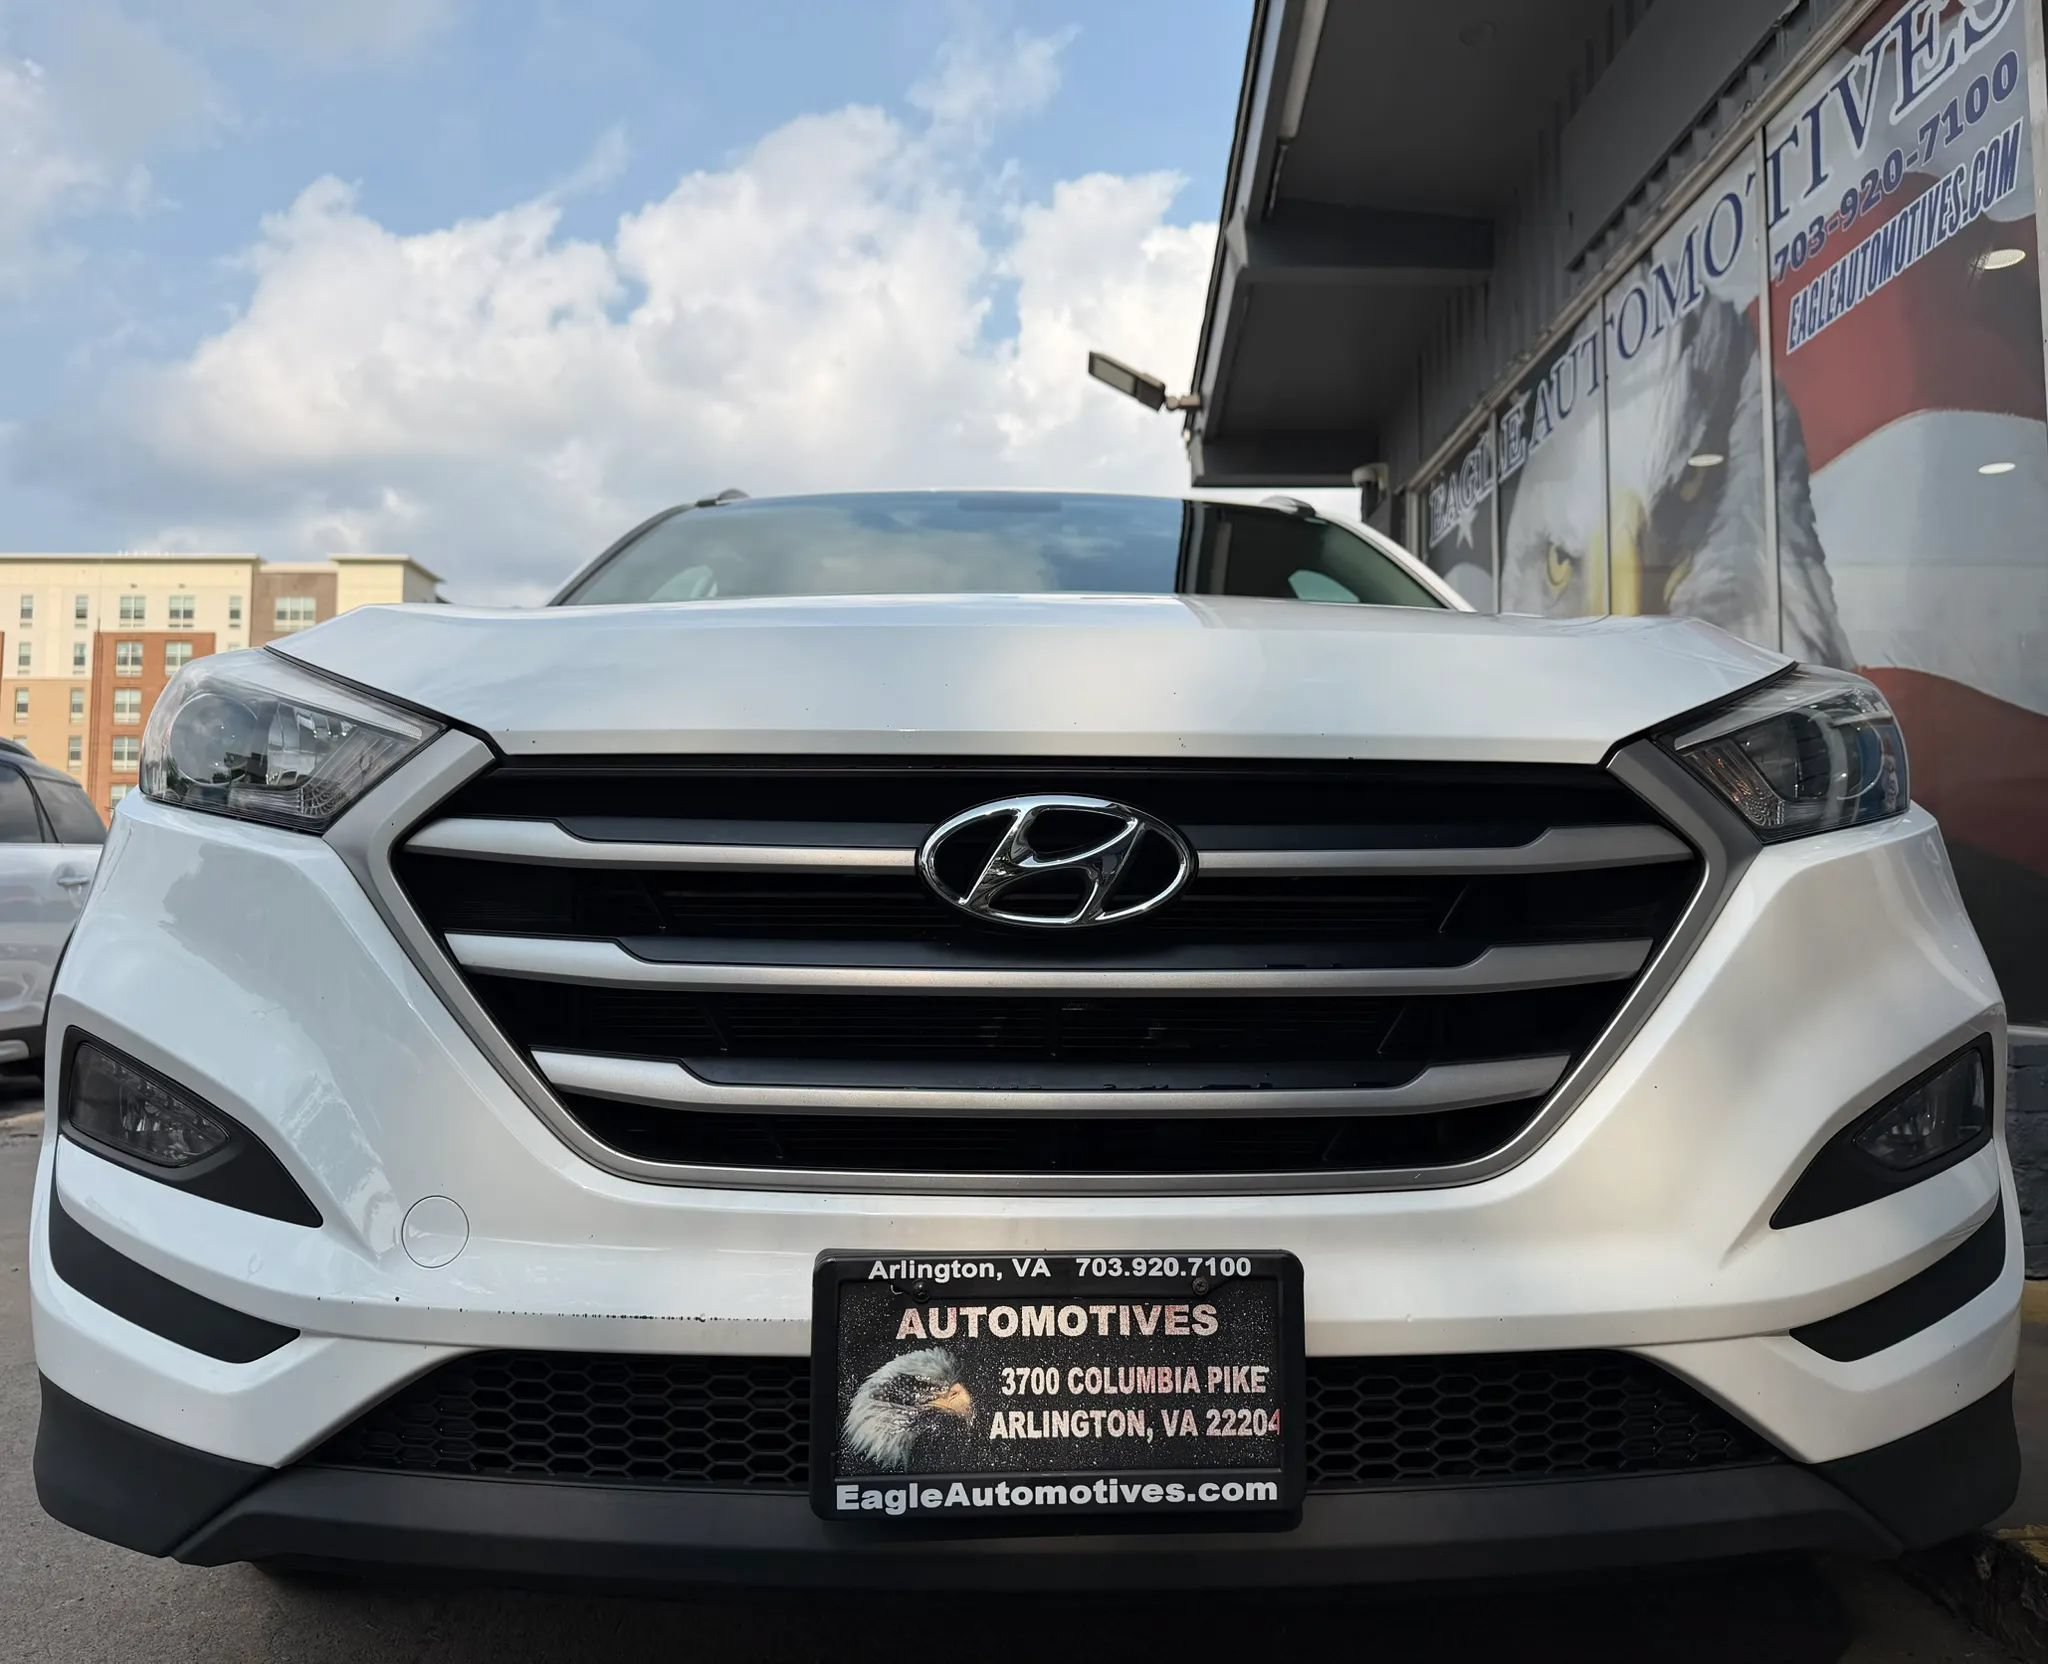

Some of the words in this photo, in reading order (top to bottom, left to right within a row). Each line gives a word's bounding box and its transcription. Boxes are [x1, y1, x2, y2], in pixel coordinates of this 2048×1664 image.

[1773, 51, 2018, 286] 703-920-7100
[1787, 119, 2022, 354] EAGLEAUTOMOTIVES.COM
[1430, 402, 1528, 547] EAGLE
[868, 1259, 1003, 1283] Arlington,
[1012, 1258, 1051, 1277] VA
[1076, 1257, 1251, 1277] 703.920.7100
[896, 1304, 1219, 1339] AUTOMOTIVES
[1001, 1366, 1059, 1395] 3700
[1067, 1366, 1200, 1394] COLUMBIA
[1207, 1365, 1270, 1393] PIKE
[989, 1410, 1154, 1442] ARLINGTON,
[1163, 1409, 1198, 1437] VA
[1206, 1408, 1280, 1437] 22204
[836, 1479, 1278, 1515] EagleAutomotives.com
